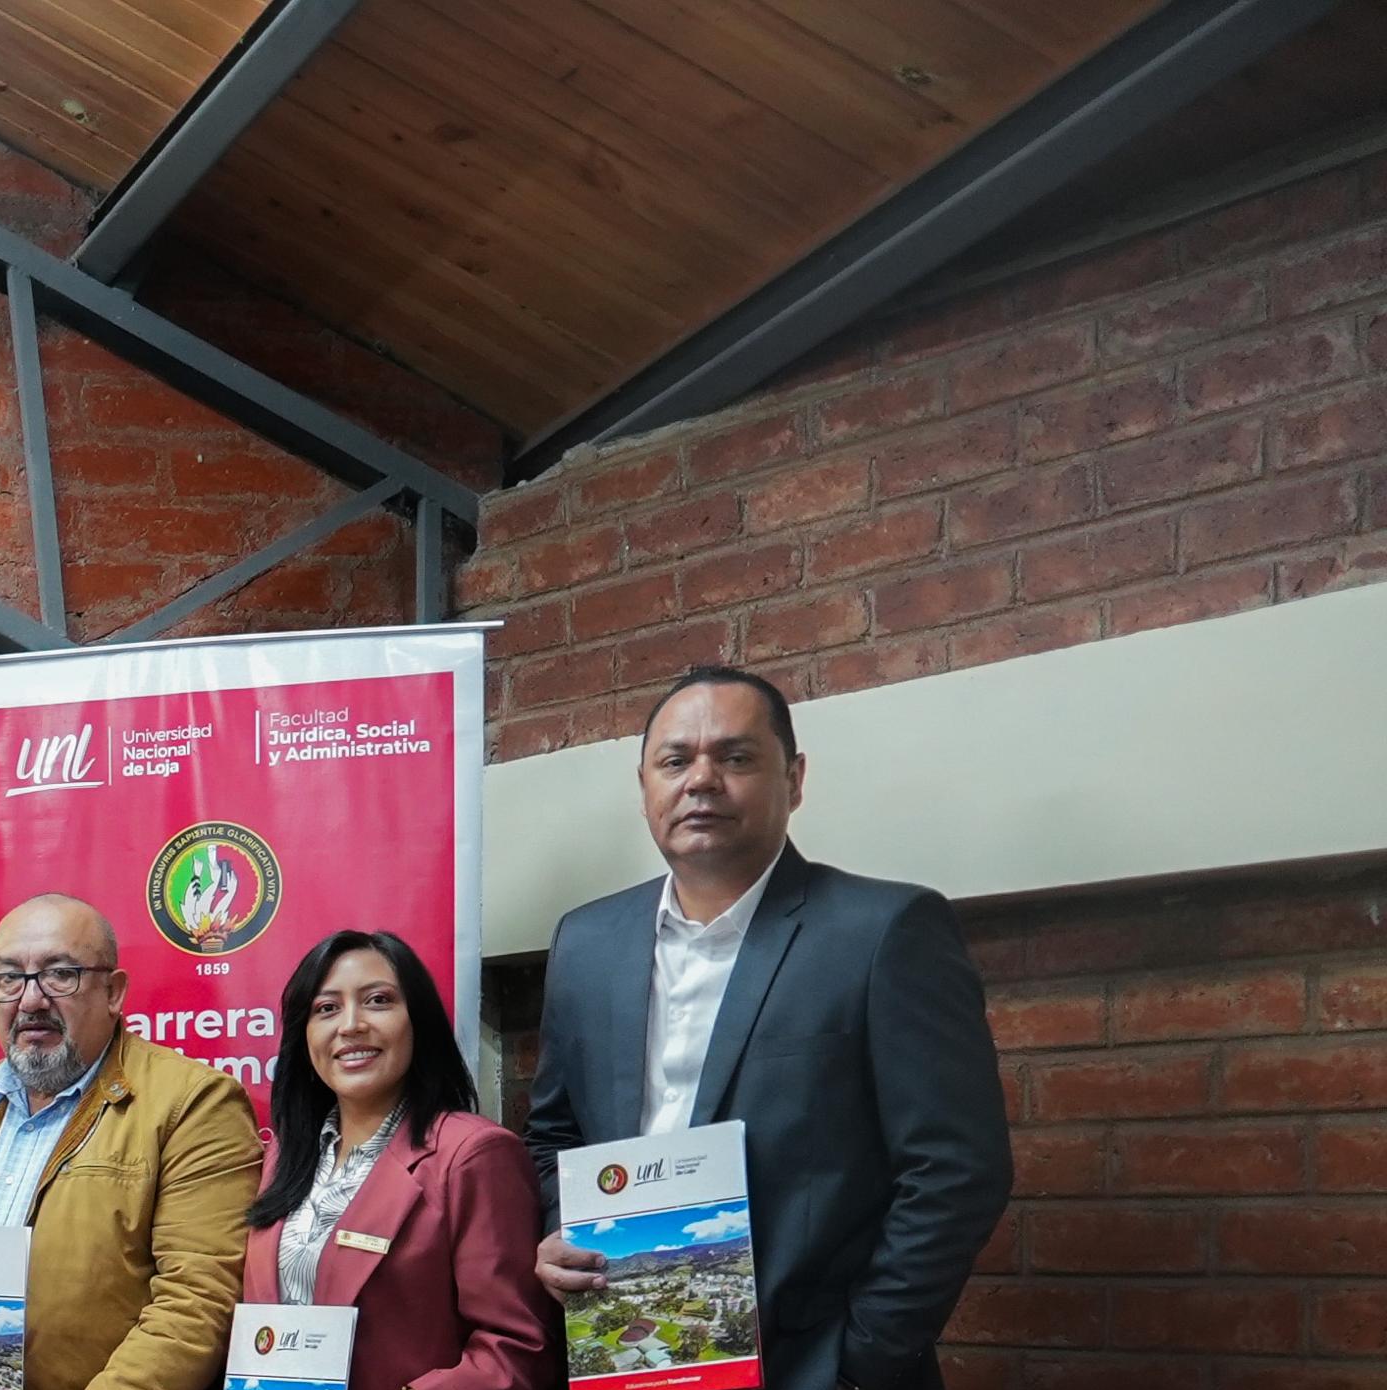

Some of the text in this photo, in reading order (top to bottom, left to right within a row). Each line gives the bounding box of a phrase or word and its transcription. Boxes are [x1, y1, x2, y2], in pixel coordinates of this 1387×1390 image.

[269, 707, 349, 727] Facultad
[122, 723, 213, 744] Universidad
[268, 719, 415, 746] Jurídica, Social
[16, 723, 96, 784] unl
[123, 742, 191, 761] Nacional
[268, 738, 430, 766] y Administrativa
[123, 760, 180, 778] de Loja
[195, 962, 230, 976] 1859
[126, 1007, 275, 1041] arrera
